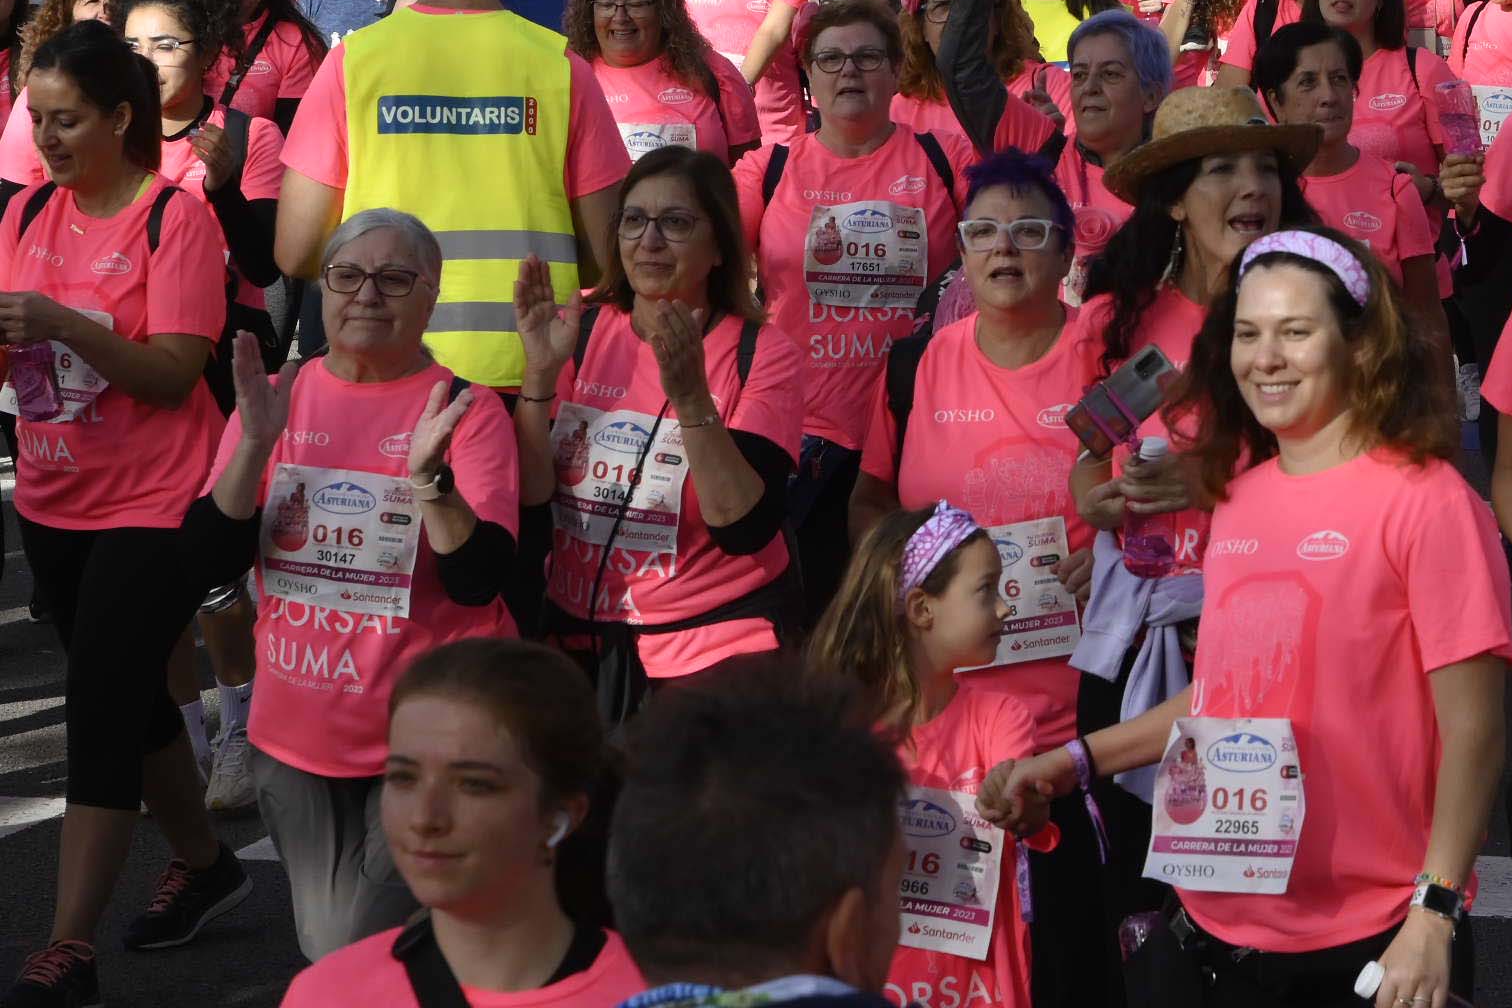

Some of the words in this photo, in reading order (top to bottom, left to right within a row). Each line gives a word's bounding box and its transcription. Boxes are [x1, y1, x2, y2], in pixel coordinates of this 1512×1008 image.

[381, 105, 521, 127] VOLUNTARIS
[803, 190, 852, 202] OYSHO
[846, 242, 888, 258] 016
[849, 262, 881, 273] 17651
[934, 408, 995, 423] OYSHO
[316, 489, 371, 509] ASTURIANA
[312, 524, 365, 548] 016
[316, 549, 357, 565] 30147
[277, 578, 319, 595] OYSHO
[352, 591, 402, 605] Santander
[1023, 635, 1072, 650] Santander
[267, 632, 360, 682] SUMA
[1213, 747, 1274, 764] ASTURIANA
[1211, 787, 1269, 812] 016
[1215, 819, 1260, 835] 22965
[1170, 840, 1215, 851] CARRERA
[1216, 842, 1230, 852] DE
[1232, 842, 1246, 852] LA
[1162, 862, 1216, 878] OYSHO
[915, 901, 951, 916] MUJER
[953, 907, 977, 922] 2023
[922, 923, 977, 945] Santander
